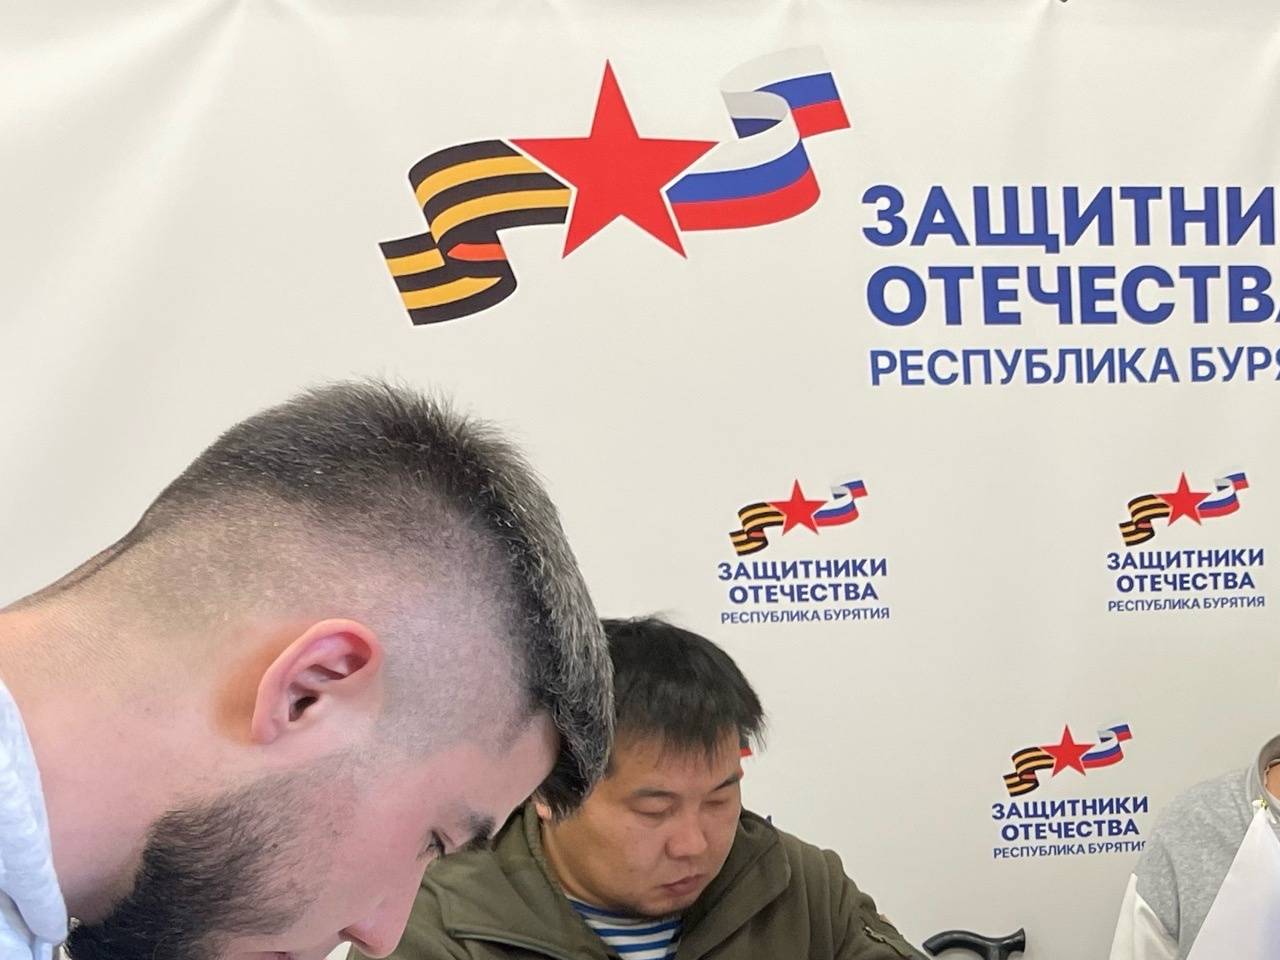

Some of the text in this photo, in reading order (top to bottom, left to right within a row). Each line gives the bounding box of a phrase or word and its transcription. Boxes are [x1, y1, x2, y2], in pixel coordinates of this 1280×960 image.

[868, 347, 1181, 387] РЕСПУБЛИКА
[717, 558, 888, 583] ЗАЩИТНИКИ
[1106, 548, 1265, 572] ЗАЩИТНИКИ
[728, 582, 879, 605] ОТЕЧЕСТВА
[1116, 571, 1256, 594] ОТЕЧЕСТВА
[1107, 595, 1265, 612] РЕСПУБЛИКА БУРЯТИЯ
[720, 606, 890, 625] РЕСПУБЛИКА БУРЯТИЯ
[991, 796, 1149, 820] ЗАЩИТНИКИ
[1001, 818, 1140, 841] ОТЕЧЕСТВА
[993, 844, 1085, 859] РЕСПУБЛИКА
